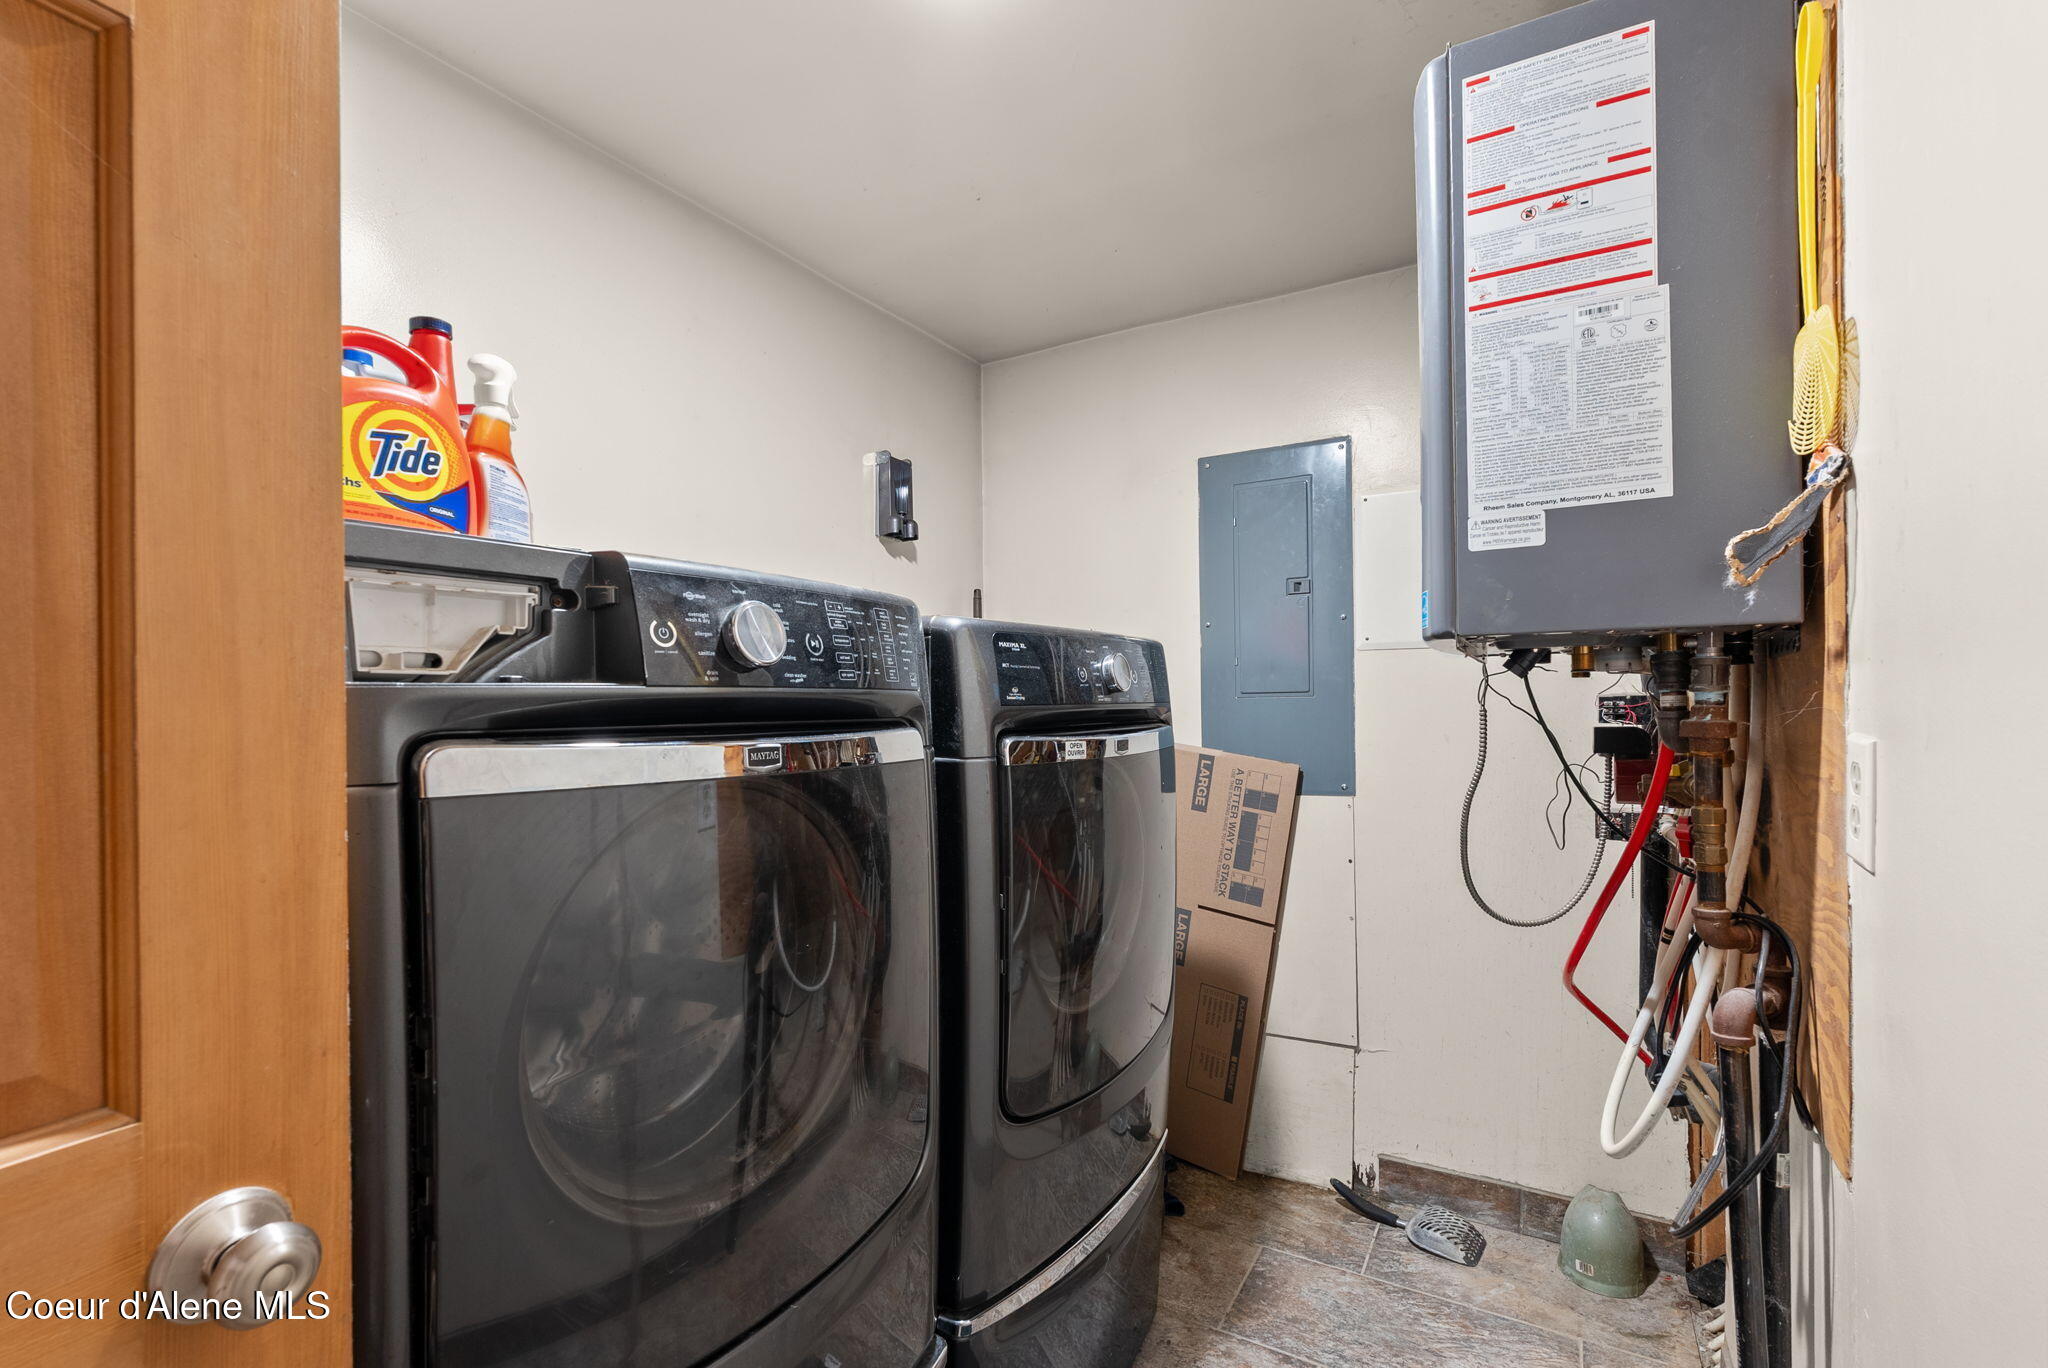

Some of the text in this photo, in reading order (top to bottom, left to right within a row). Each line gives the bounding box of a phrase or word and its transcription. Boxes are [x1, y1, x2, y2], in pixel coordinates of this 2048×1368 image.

[1581, 39, 1613, 52] OPERATING
[1520, 106, 1589, 127] OPERATING INSTRUCTIONS
[1569, 161, 1599, 172] APPLIANCE
[368, 429, 442, 478] Tide
[1525, 499, 1558, 507] Company,
[1559, 494, 1602, 503] Montgomery
[1617, 489, 1637, 497] 36117
[1639, 487, 1656, 495] USA
[1503, 514, 1542, 523] AVERTISSEMENT
[750, 751, 779, 761] MAYTAG
[1067, 749, 1085, 757] OUVRIR
[1195, 759, 1212, 807] LARGE
[1217, 768, 1245, 897] A BETTER WAY TO STACK
[1176, 913, 1188, 961] LARGE
